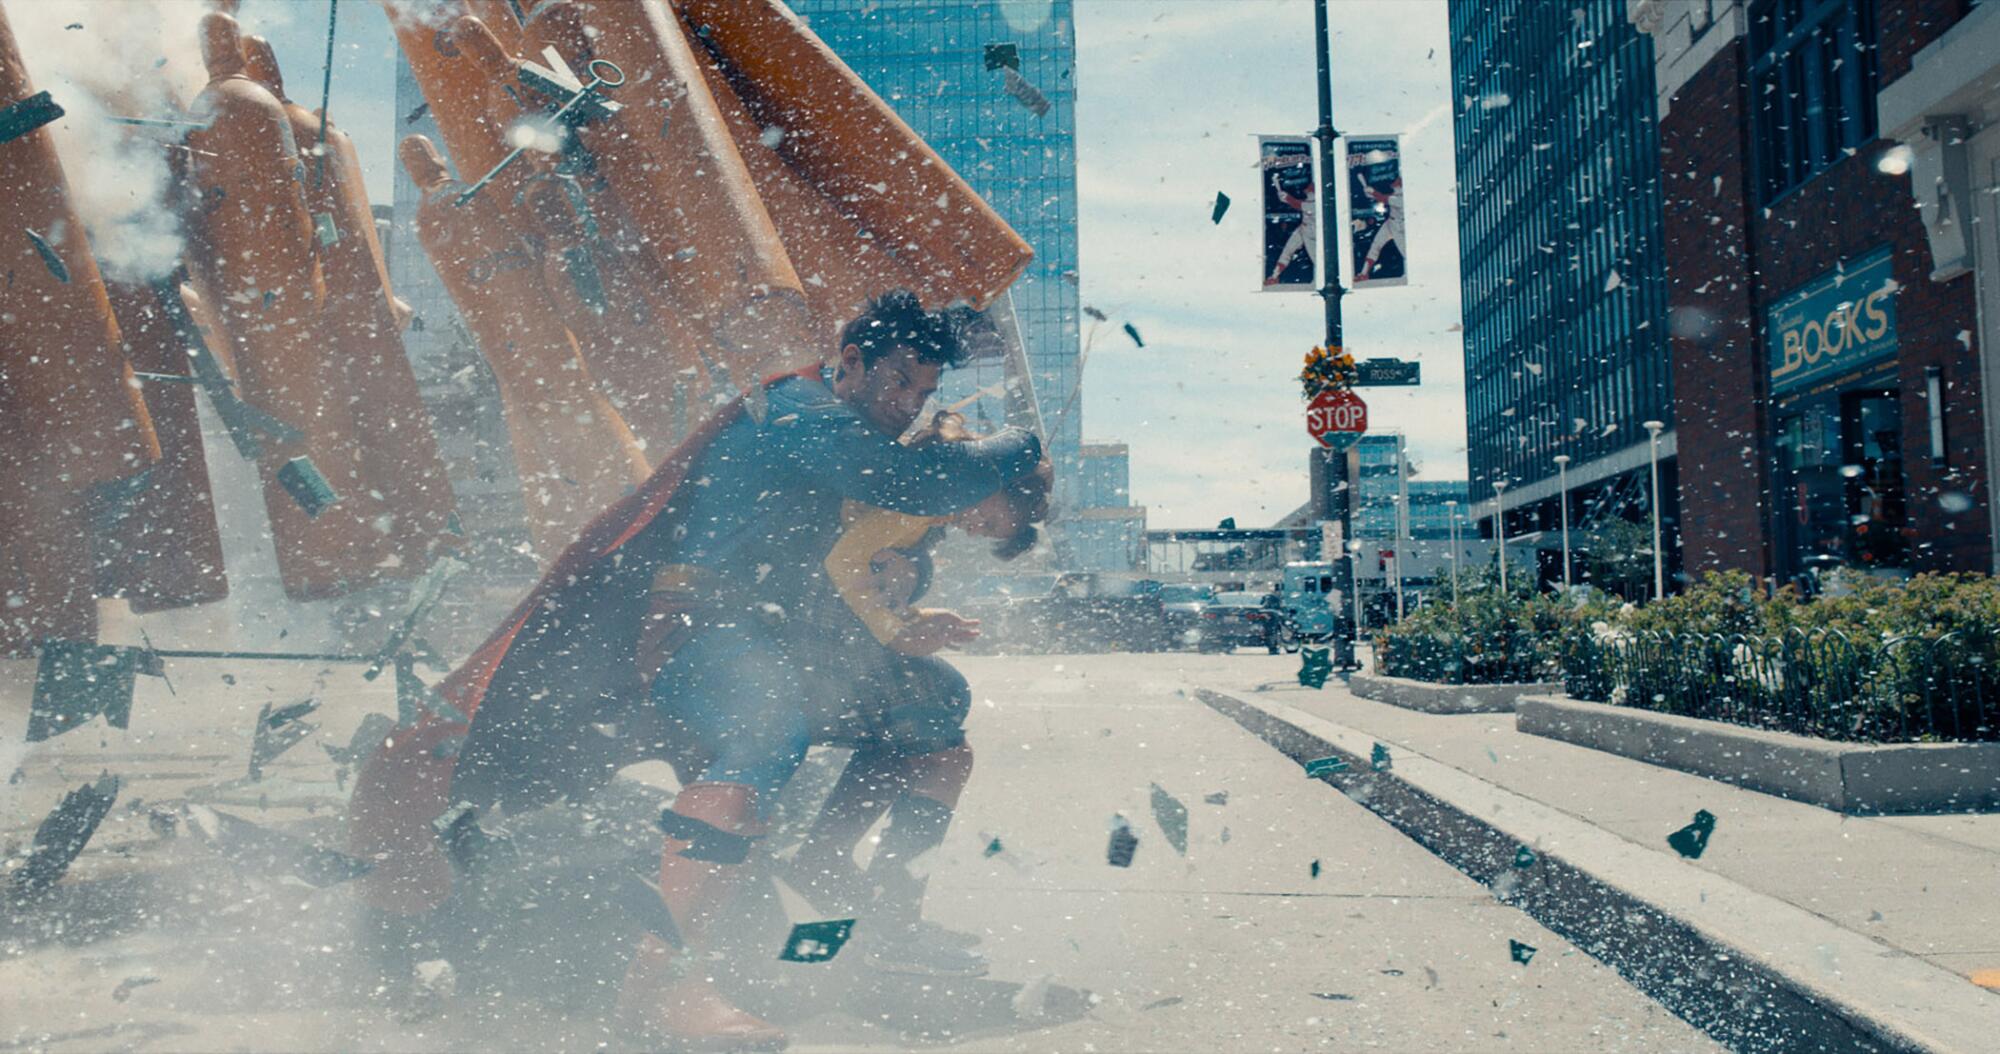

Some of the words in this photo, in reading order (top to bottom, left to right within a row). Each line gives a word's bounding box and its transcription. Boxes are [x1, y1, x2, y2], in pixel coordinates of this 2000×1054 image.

[1771, 288, 1889, 378] BOOKS
[1370, 369, 1396, 380] ROSS
[1311, 406, 1363, 430] STOP
